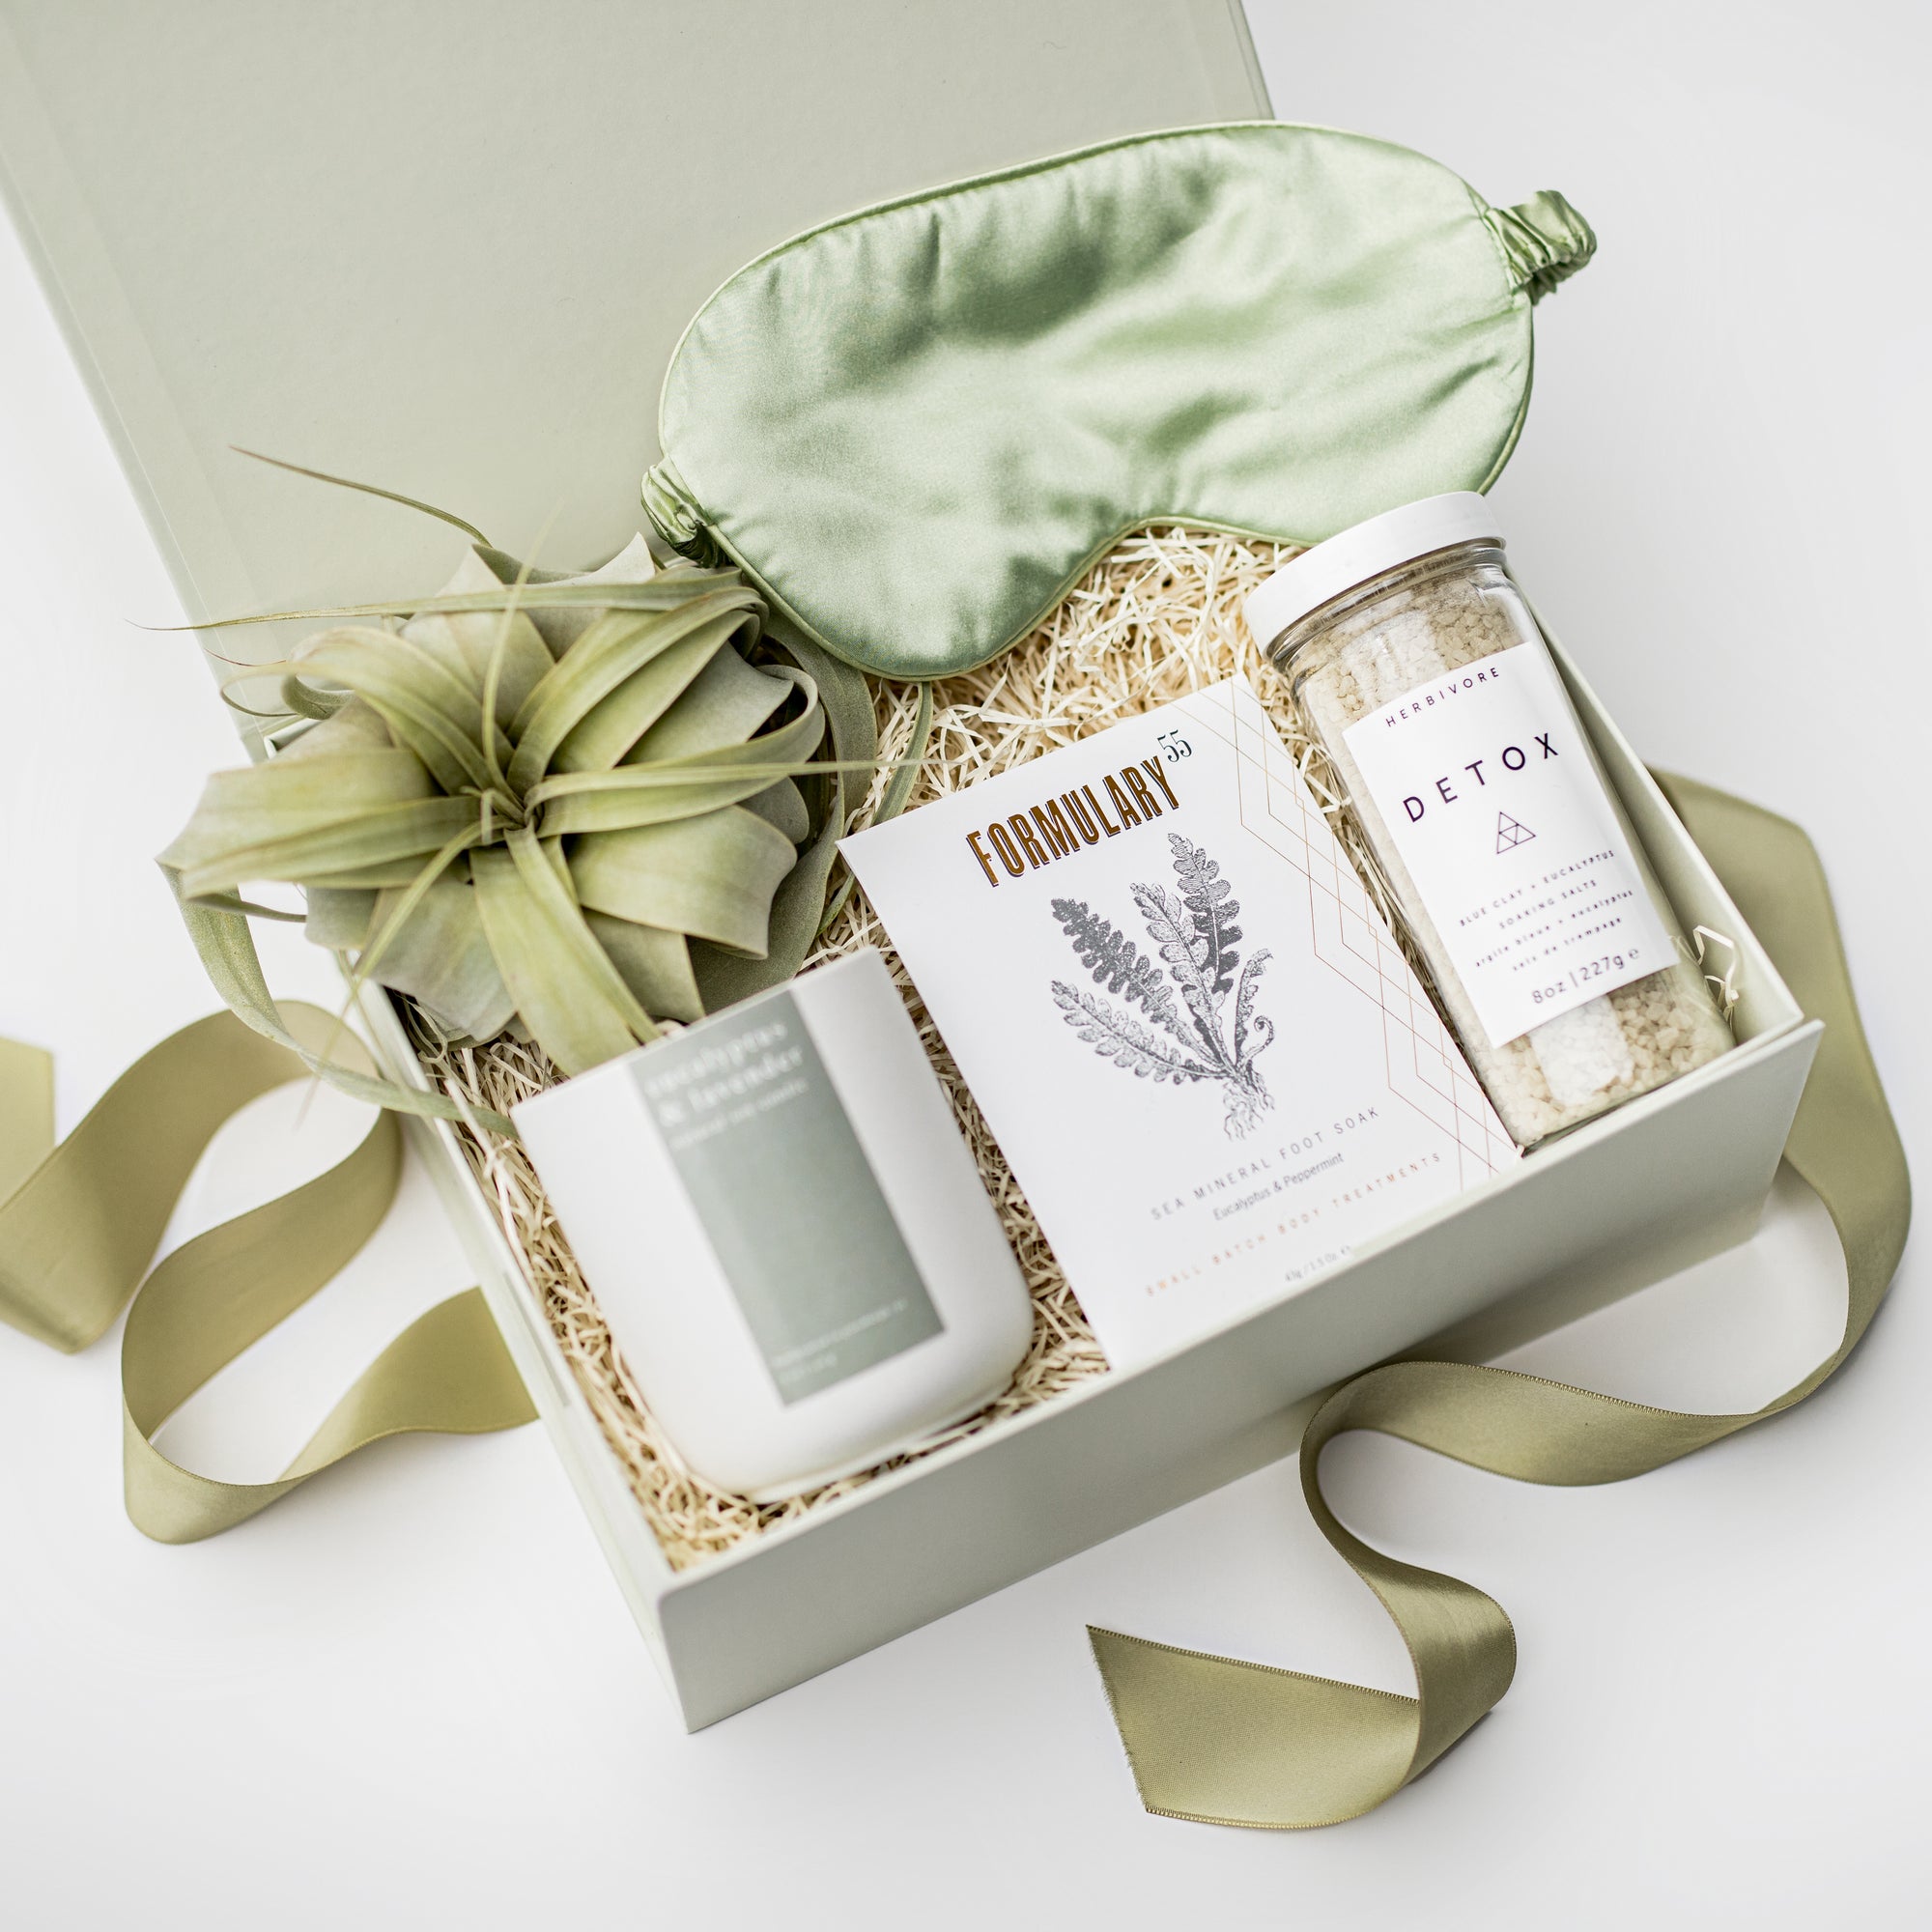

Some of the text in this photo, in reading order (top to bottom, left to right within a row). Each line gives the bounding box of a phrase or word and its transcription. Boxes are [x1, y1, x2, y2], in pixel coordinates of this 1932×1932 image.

[1385, 667, 1499, 727] HERBIVORE
[966, 728, 1193, 888] FORMULARY 55
[1403, 732, 1559, 823] DETOX
[1459, 907, 1487, 927] BLUE
[1492, 888, 1522, 909] CLAY
[1544, 849, 1615, 884] EUCALYPTUS
[1499, 879, 1597, 930] SOAKING SALTS
[1571, 890, 1634, 920] eucalyptus
[1531, 980, 1567, 1005] 8oz
[1579, 952, 1625, 982] 227g
[1150, 1105, 1379, 1221] SEA MINERAL FOOT SOAK
[1212, 1151, 1345, 1222] Eucalyptus & Peppermint
[1145, 1151, 1441, 1297] SMALL BATCH BODY TREATMENTS
